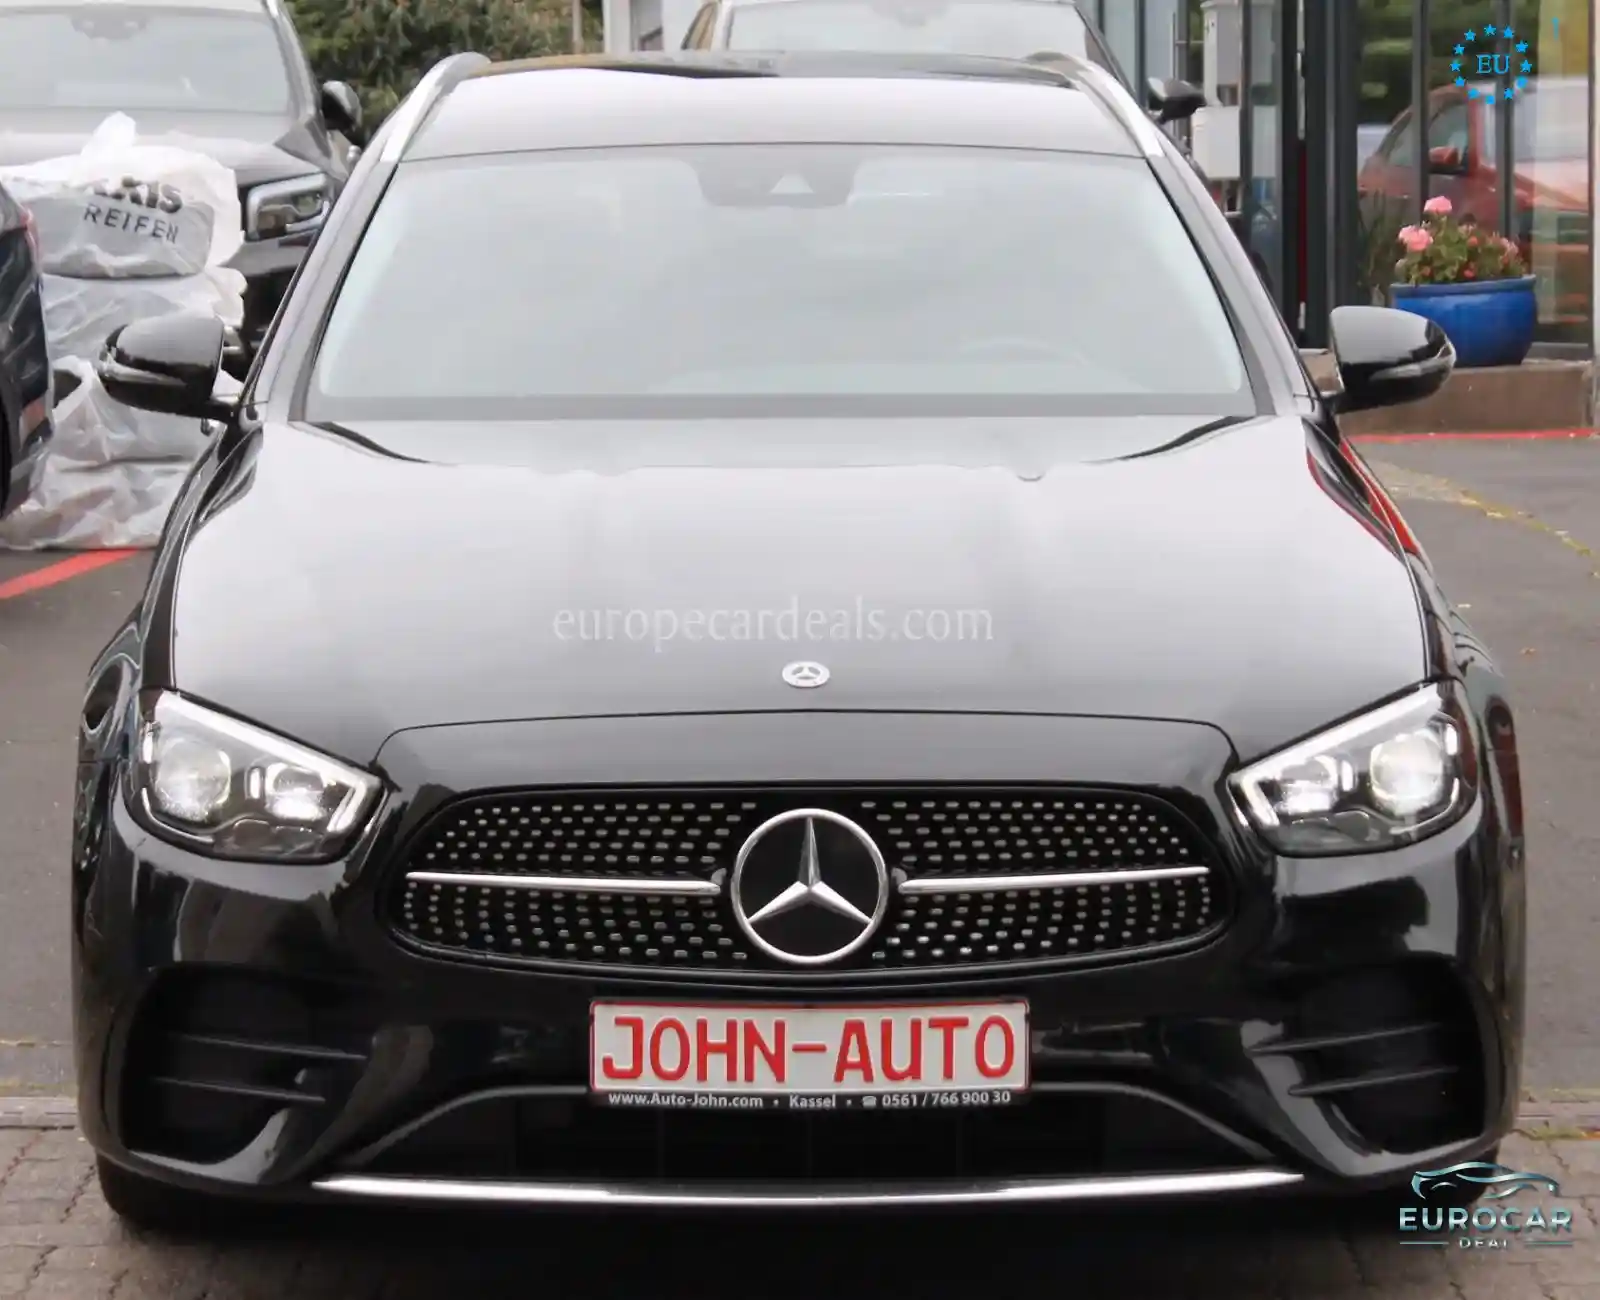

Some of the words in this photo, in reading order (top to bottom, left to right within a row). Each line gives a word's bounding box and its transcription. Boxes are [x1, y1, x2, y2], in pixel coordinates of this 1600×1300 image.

[84, 203, 179, 244] REIFEN
[602, 1015, 1015, 1083] JOHN-AUTO
[608, 1092, 764, 1108] www.Auto-John.com
[789, 1093, 836, 1108] Kassel
[882, 1093, 918, 1107] 0561
[931, 1091, 958, 1106] 766
[961, 1090, 989, 1105] 900
[992, 1090, 1012, 1104] 30
